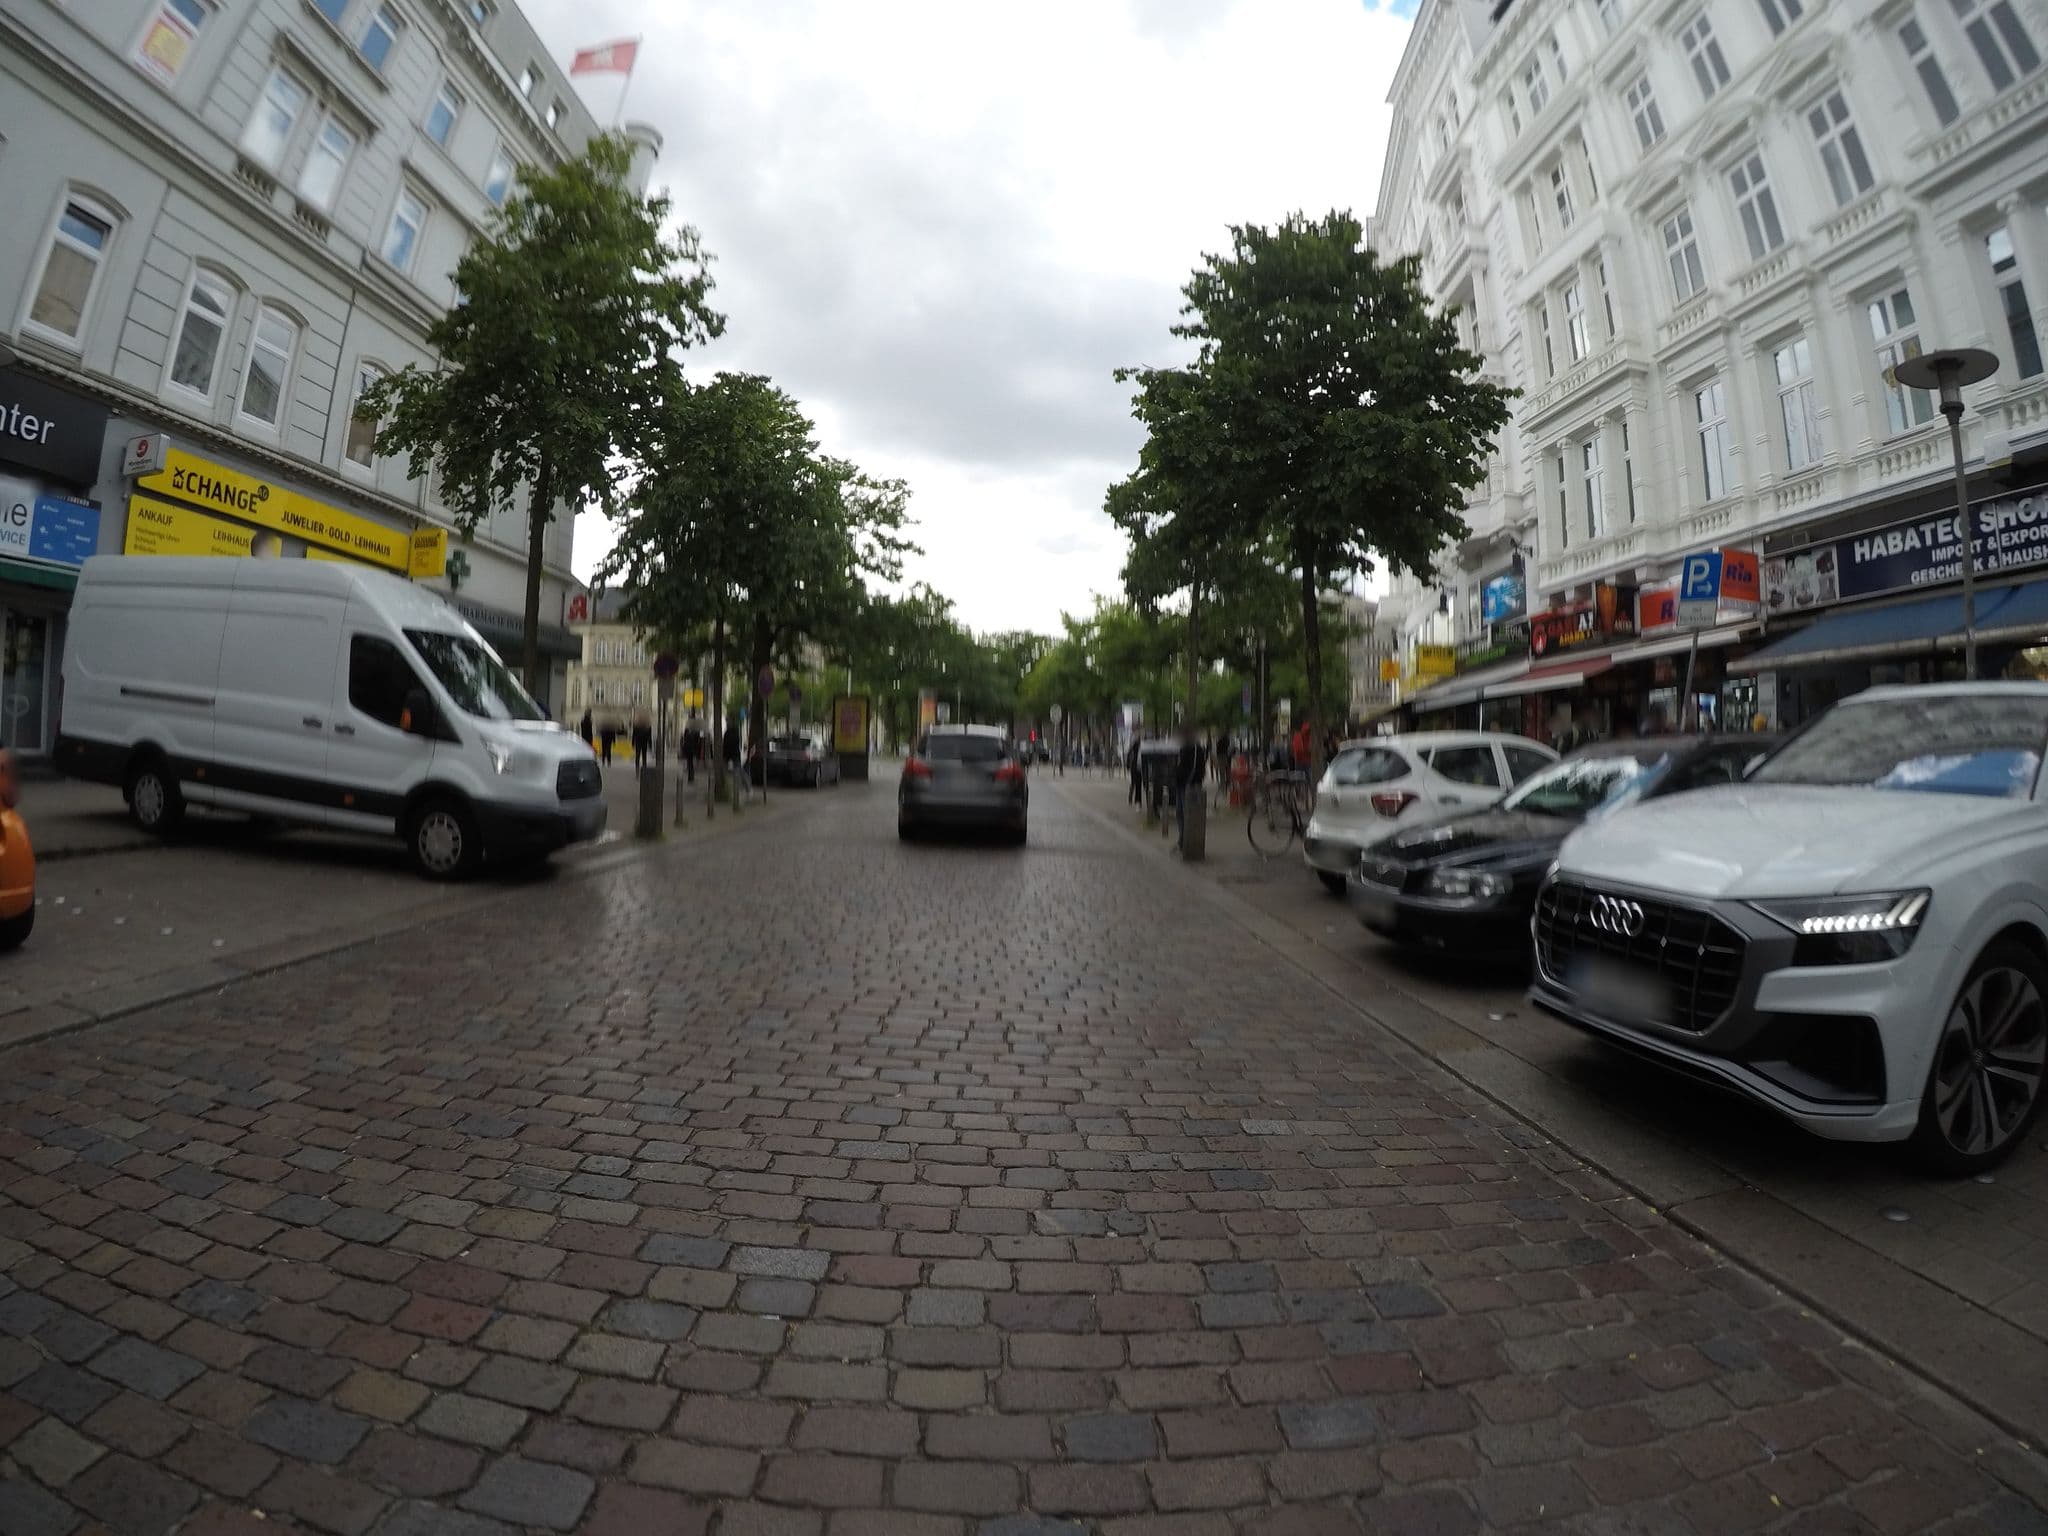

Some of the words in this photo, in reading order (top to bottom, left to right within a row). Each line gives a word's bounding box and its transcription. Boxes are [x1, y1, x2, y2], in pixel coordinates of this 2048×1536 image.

[138, 507, 173, 526] ANKAUF
[281, 511, 325, 535] JUWELIER
[328, 527, 351, 543] GOLD
[212, 528, 250, 548] LEIHHAUS
[1986, 536, 1998, 550] &
[1686, 558, 1710, 597] P
[1911, 560, 1984, 584] GESCHEK
[1987, 556, 1999, 569] &
